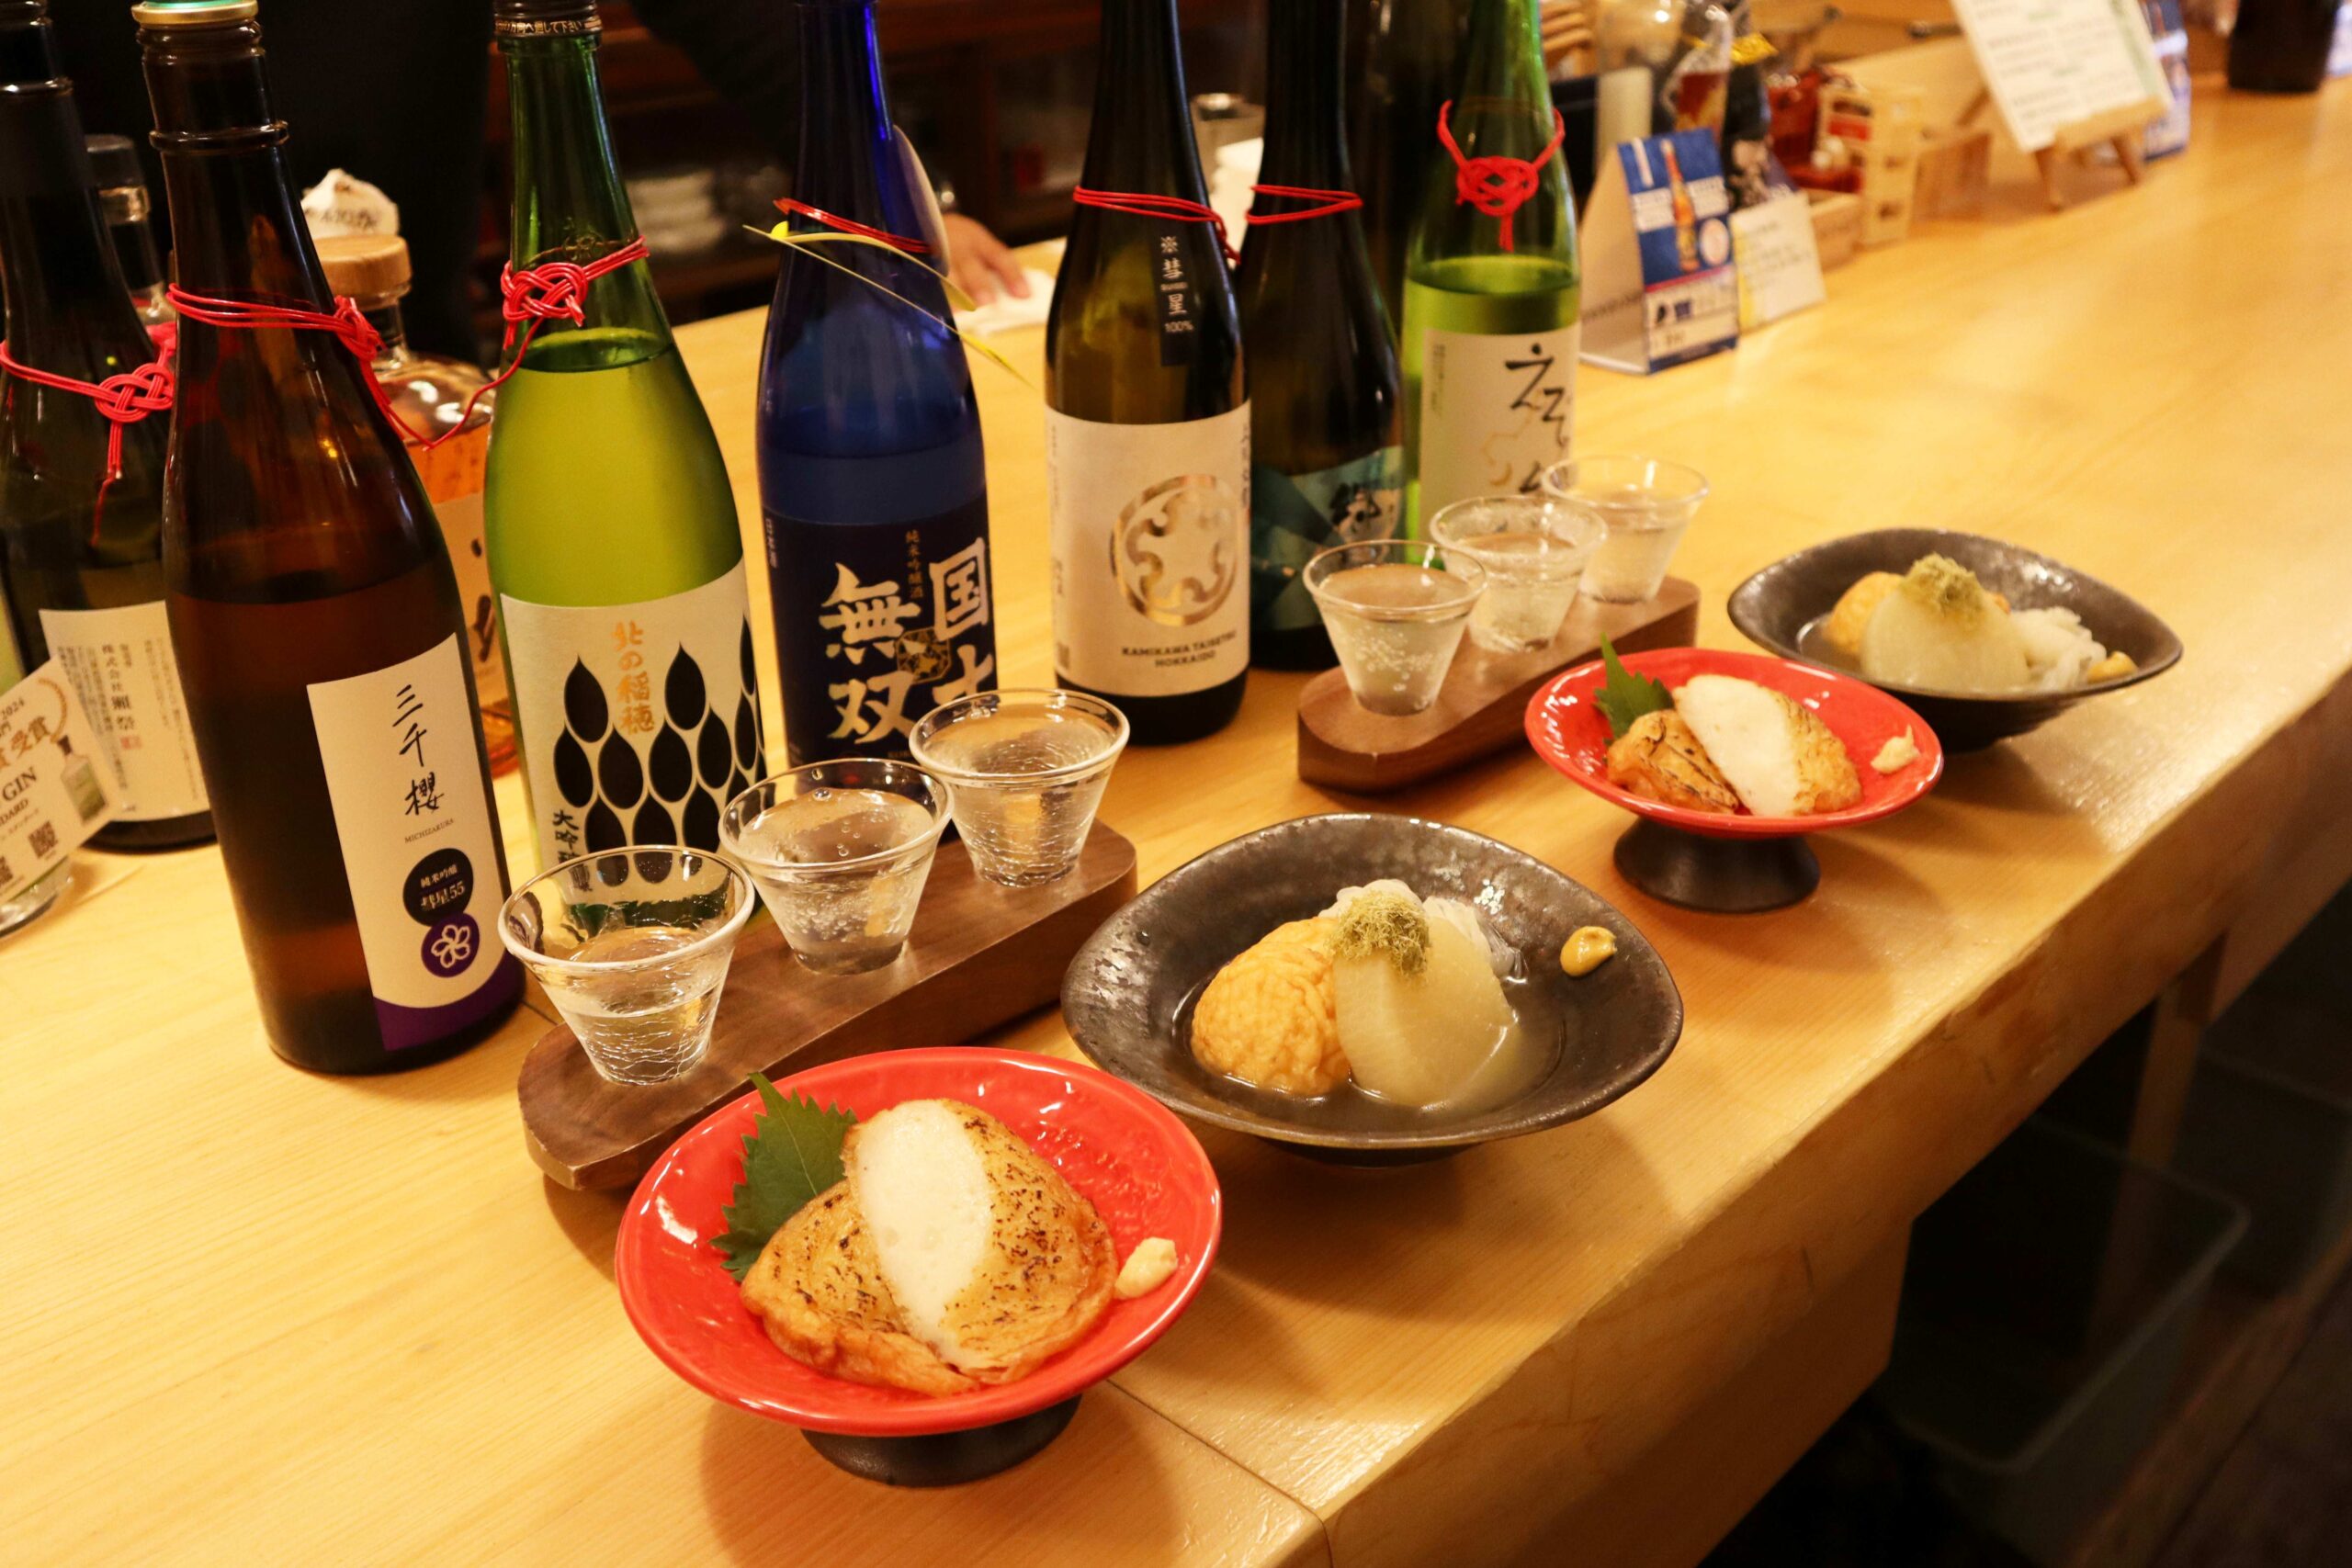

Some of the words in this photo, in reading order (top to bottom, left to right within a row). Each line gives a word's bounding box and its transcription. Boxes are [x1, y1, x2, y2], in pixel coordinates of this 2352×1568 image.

[2, 764, 38, 802] GIN
[392, 684, 445, 816] 三千櫻
